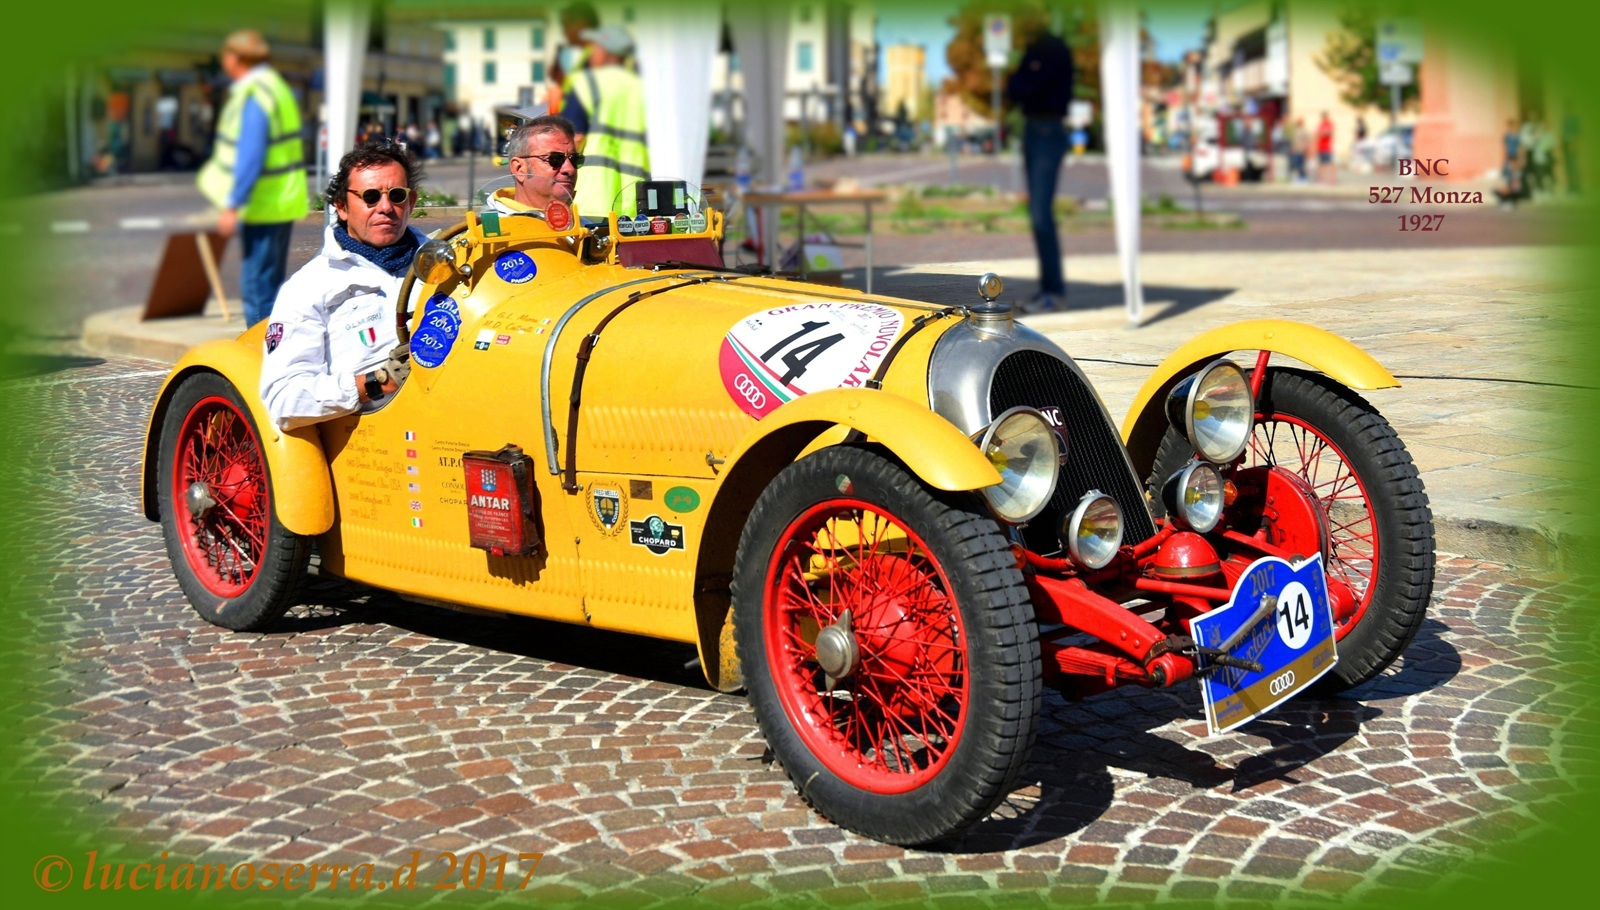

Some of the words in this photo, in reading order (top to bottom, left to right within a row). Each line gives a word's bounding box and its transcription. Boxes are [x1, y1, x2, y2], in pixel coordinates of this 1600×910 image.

[501, 257, 525, 271] 2015
[510, 273, 534, 283] PASSED
[767, 303, 832, 316] GRAN
[839, 303, 897, 318] PREMIO
[429, 316, 453, 333] 2016
[420, 333, 443, 350] 2017
[411, 351, 433, 368] PASSED
[759, 320, 846, 388] 14
[838, 319, 900, 388] NUVOLAR
[1041, 409, 1063, 427] NC
[471, 494, 510, 511] ANTAR
[605, 490, 619, 498] MELLO
[638, 536, 677, 547] CHOPARD
[1250, 563, 1276, 597] 2017
[1279, 592, 1310, 640] 14
